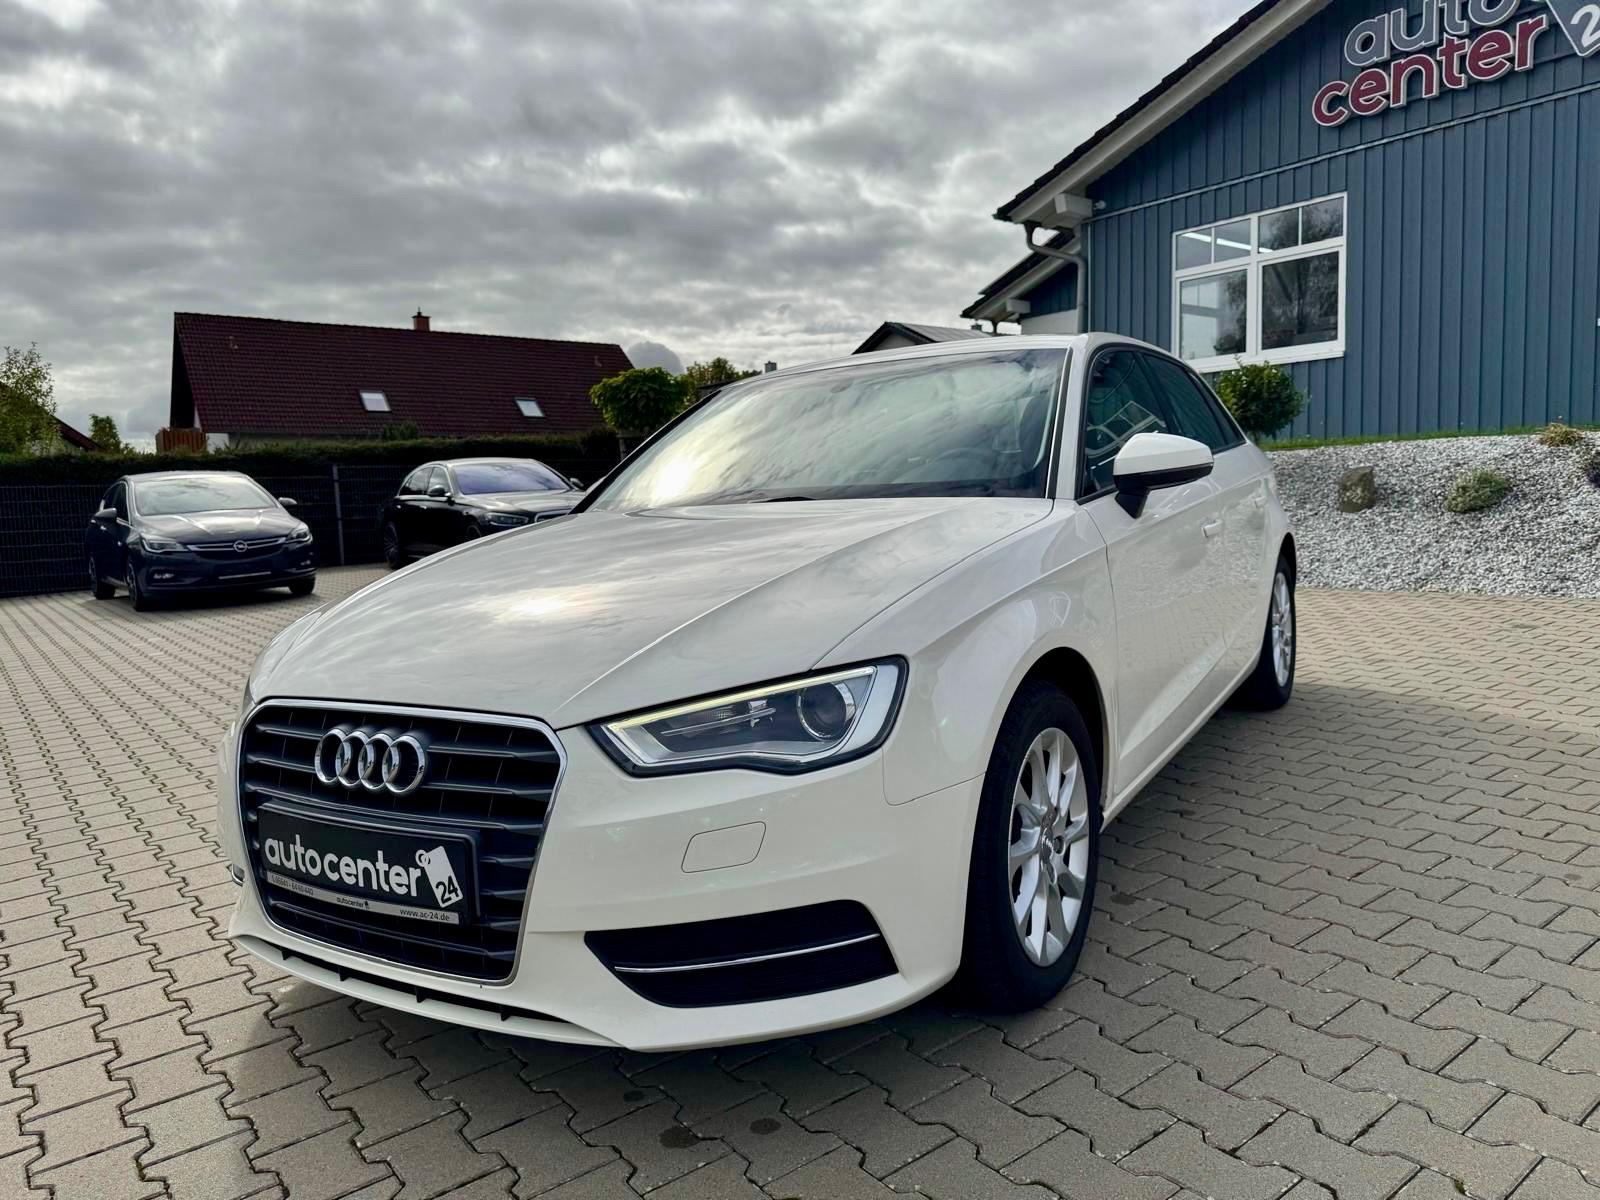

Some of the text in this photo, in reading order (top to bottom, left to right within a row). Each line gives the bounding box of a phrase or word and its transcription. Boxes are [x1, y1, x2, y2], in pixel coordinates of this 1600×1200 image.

[1311, 14, 1548, 127] center
[264, 834, 459, 902] autocenter 24
[336, 896, 365, 909] autocenter
[399, 908, 450, 922] www.ac-24.de
